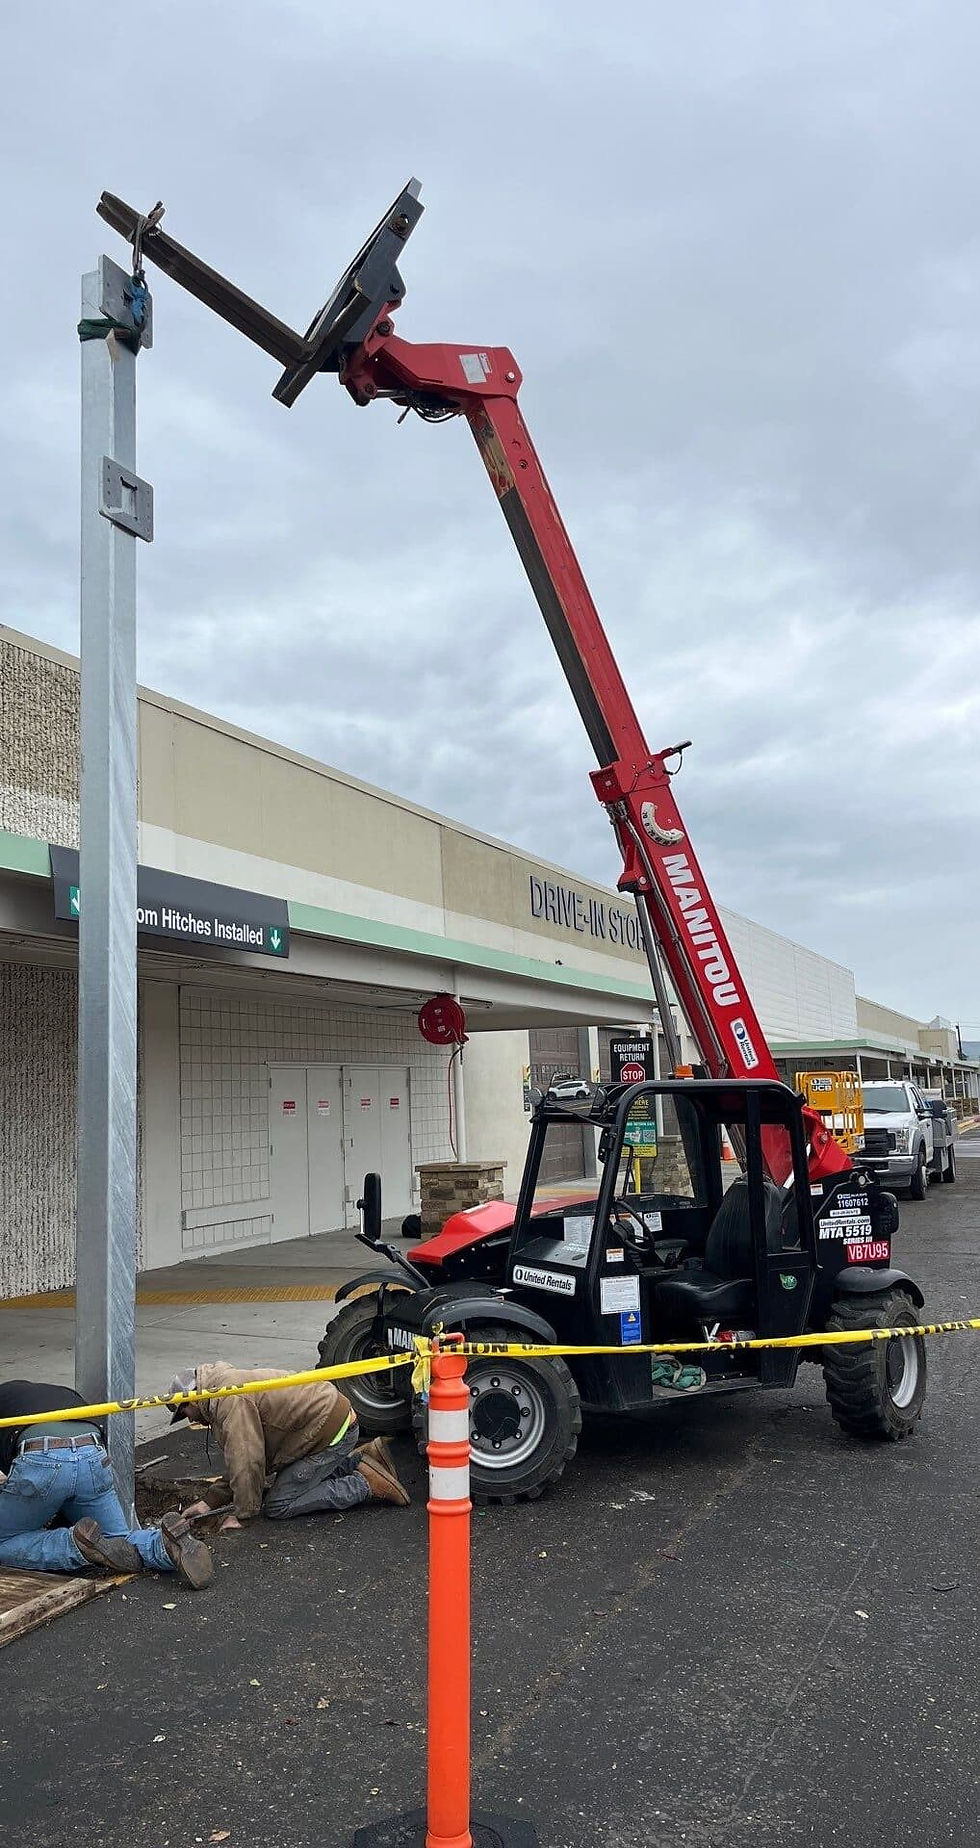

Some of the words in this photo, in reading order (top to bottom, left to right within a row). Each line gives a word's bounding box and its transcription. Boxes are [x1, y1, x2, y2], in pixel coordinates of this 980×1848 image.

[529, 875, 606, 939] DRIVE-IN
[136, 908, 158, 927] om
[162, 908, 212, 936] Hitches
[214, 918, 264, 946] Installed
[661, 853, 741, 1007] MANITOU
[613, 1043, 650, 1053] EQUIPMENT
[619, 1052, 645, 1062] RETURN
[622, 1070, 644, 1080] STOP
[819, 1227, 844, 1239] MTA
[845, 1224, 872, 1237] 5519
[848, 1242, 889, 1260] VB7U95
[523, 1270, 546, 1285] United
[546, 1275, 572, 1291] Rentals
